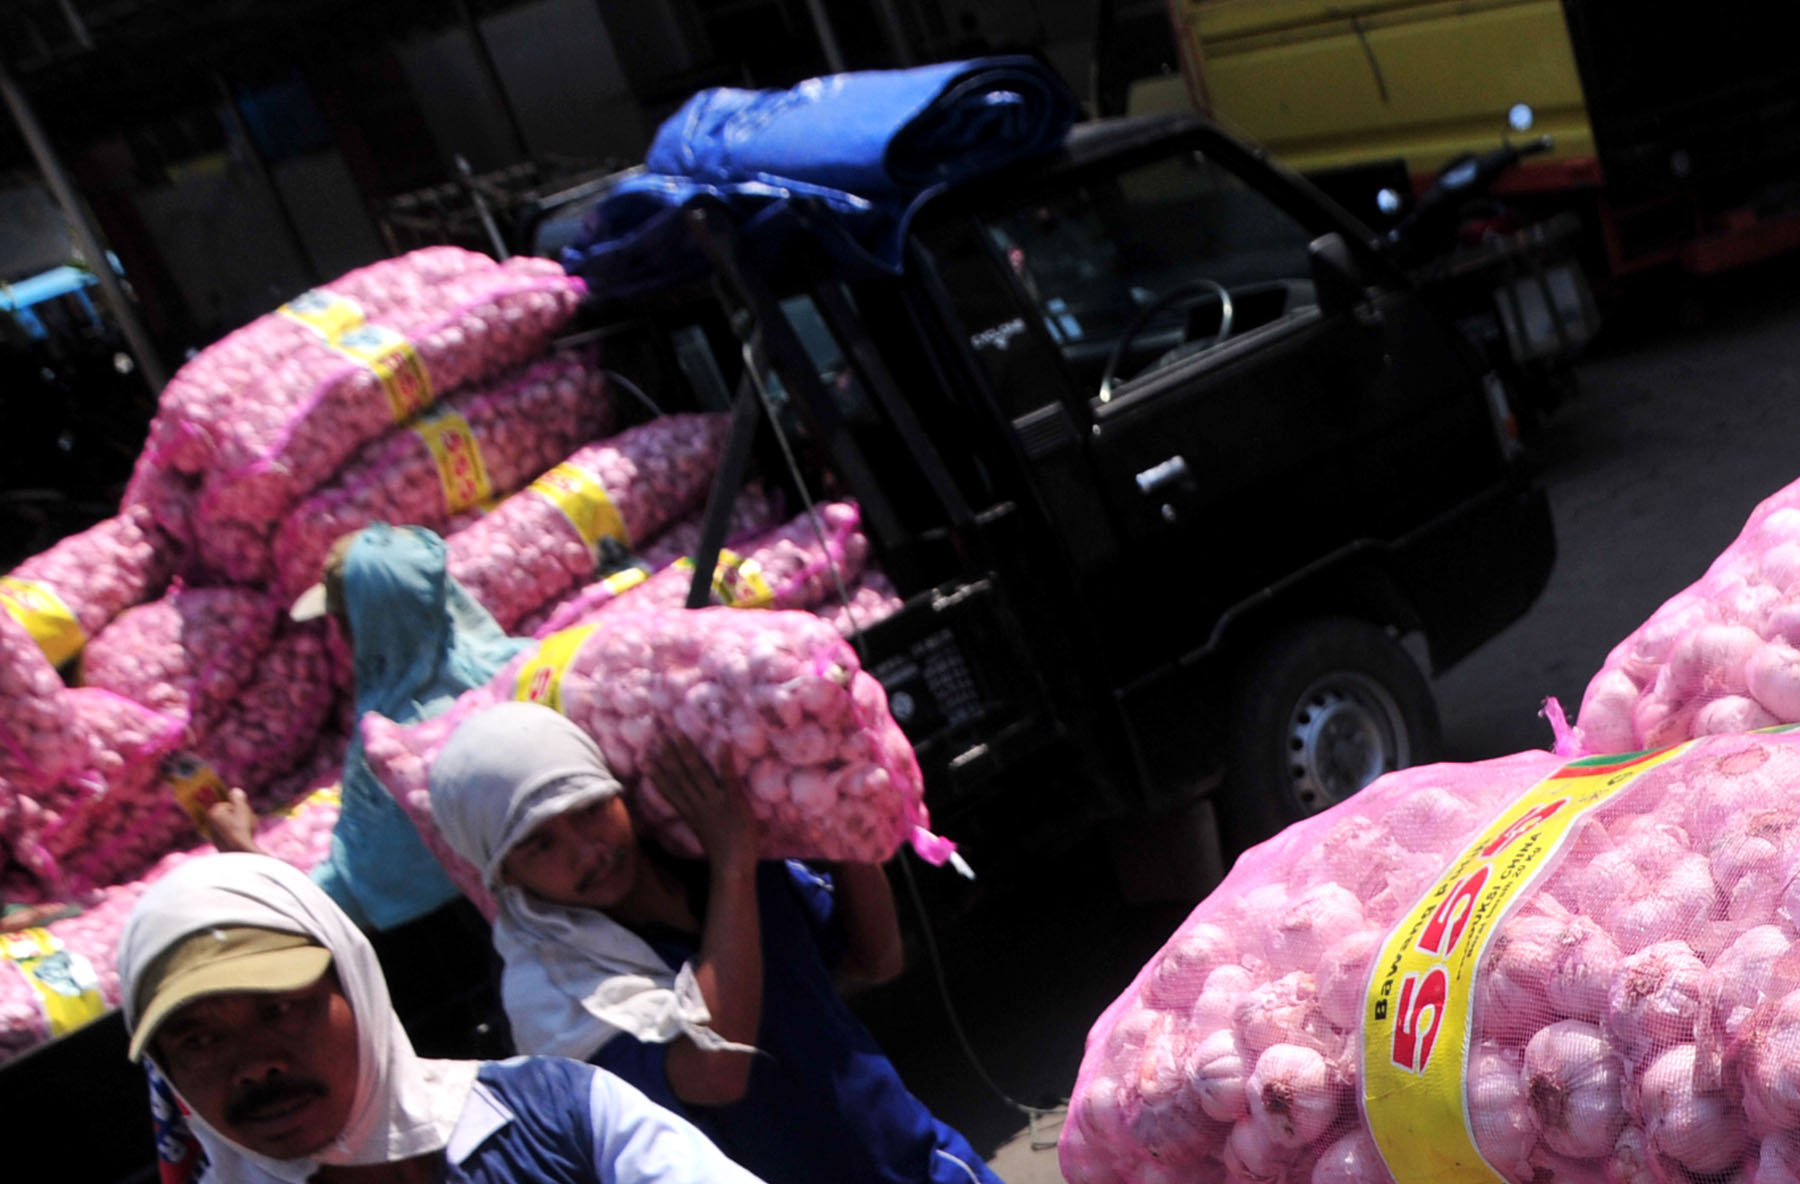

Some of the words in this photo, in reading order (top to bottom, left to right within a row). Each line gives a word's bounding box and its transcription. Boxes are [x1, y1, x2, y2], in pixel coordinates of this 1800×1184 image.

[1498, 830, 1541, 881] CHINA
[1374, 905, 1437, 1021] Bawang
[1393, 800, 1566, 1071] 555
